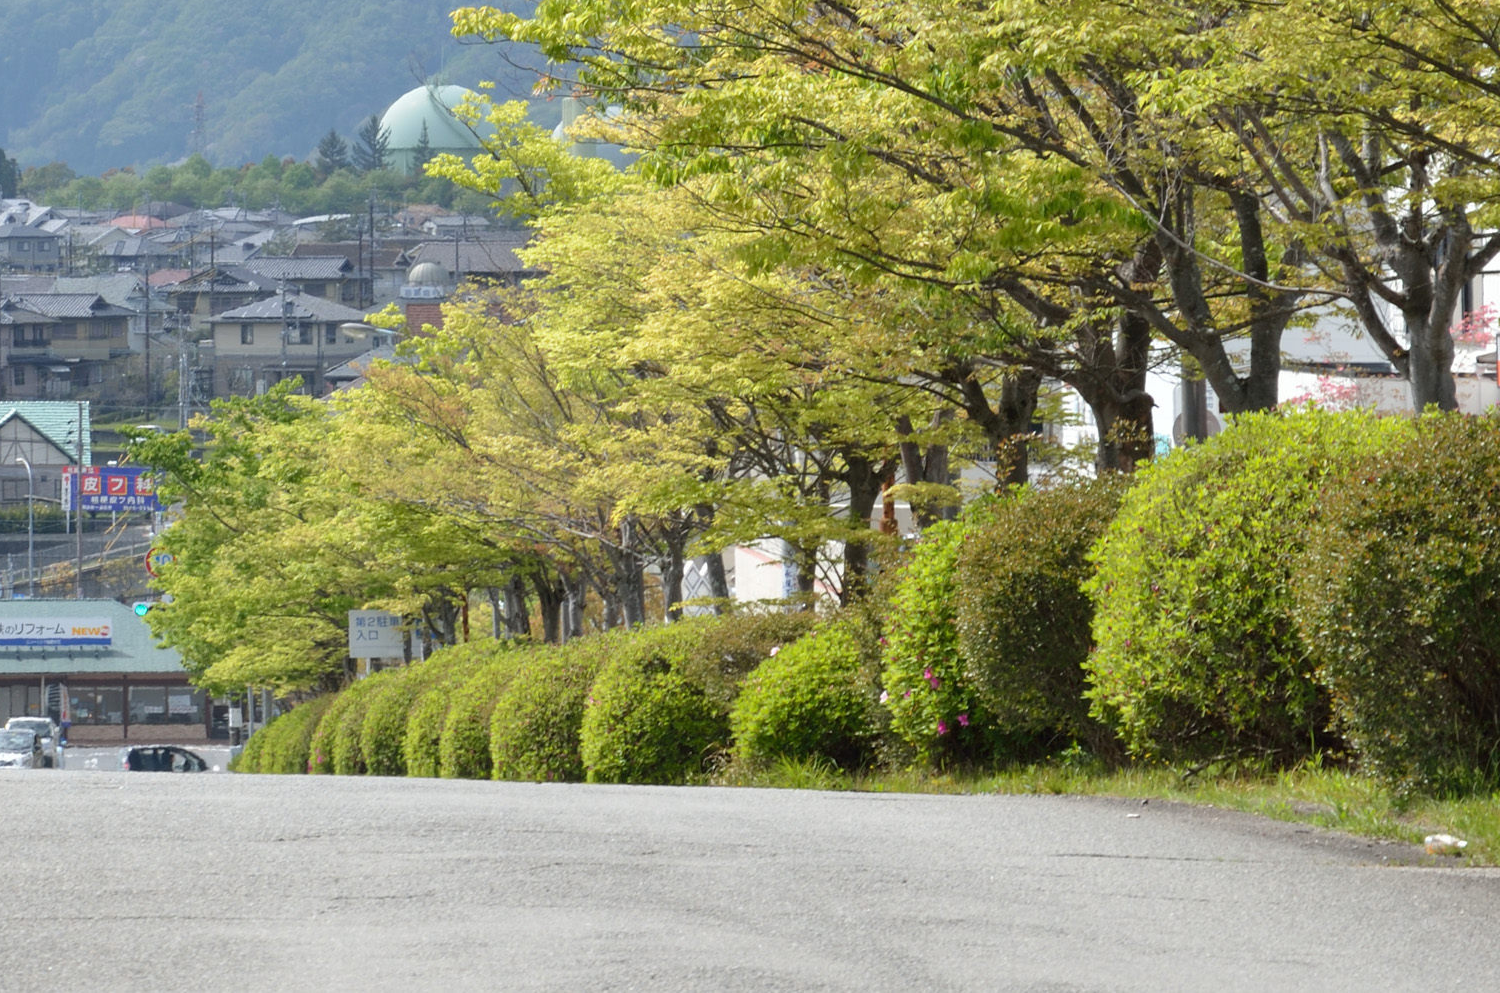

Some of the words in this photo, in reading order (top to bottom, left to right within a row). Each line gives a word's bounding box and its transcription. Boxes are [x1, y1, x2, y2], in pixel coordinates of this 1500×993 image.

[84, 477, 152, 492] 皮フ科
[356, 630, 379, 641] 入口
